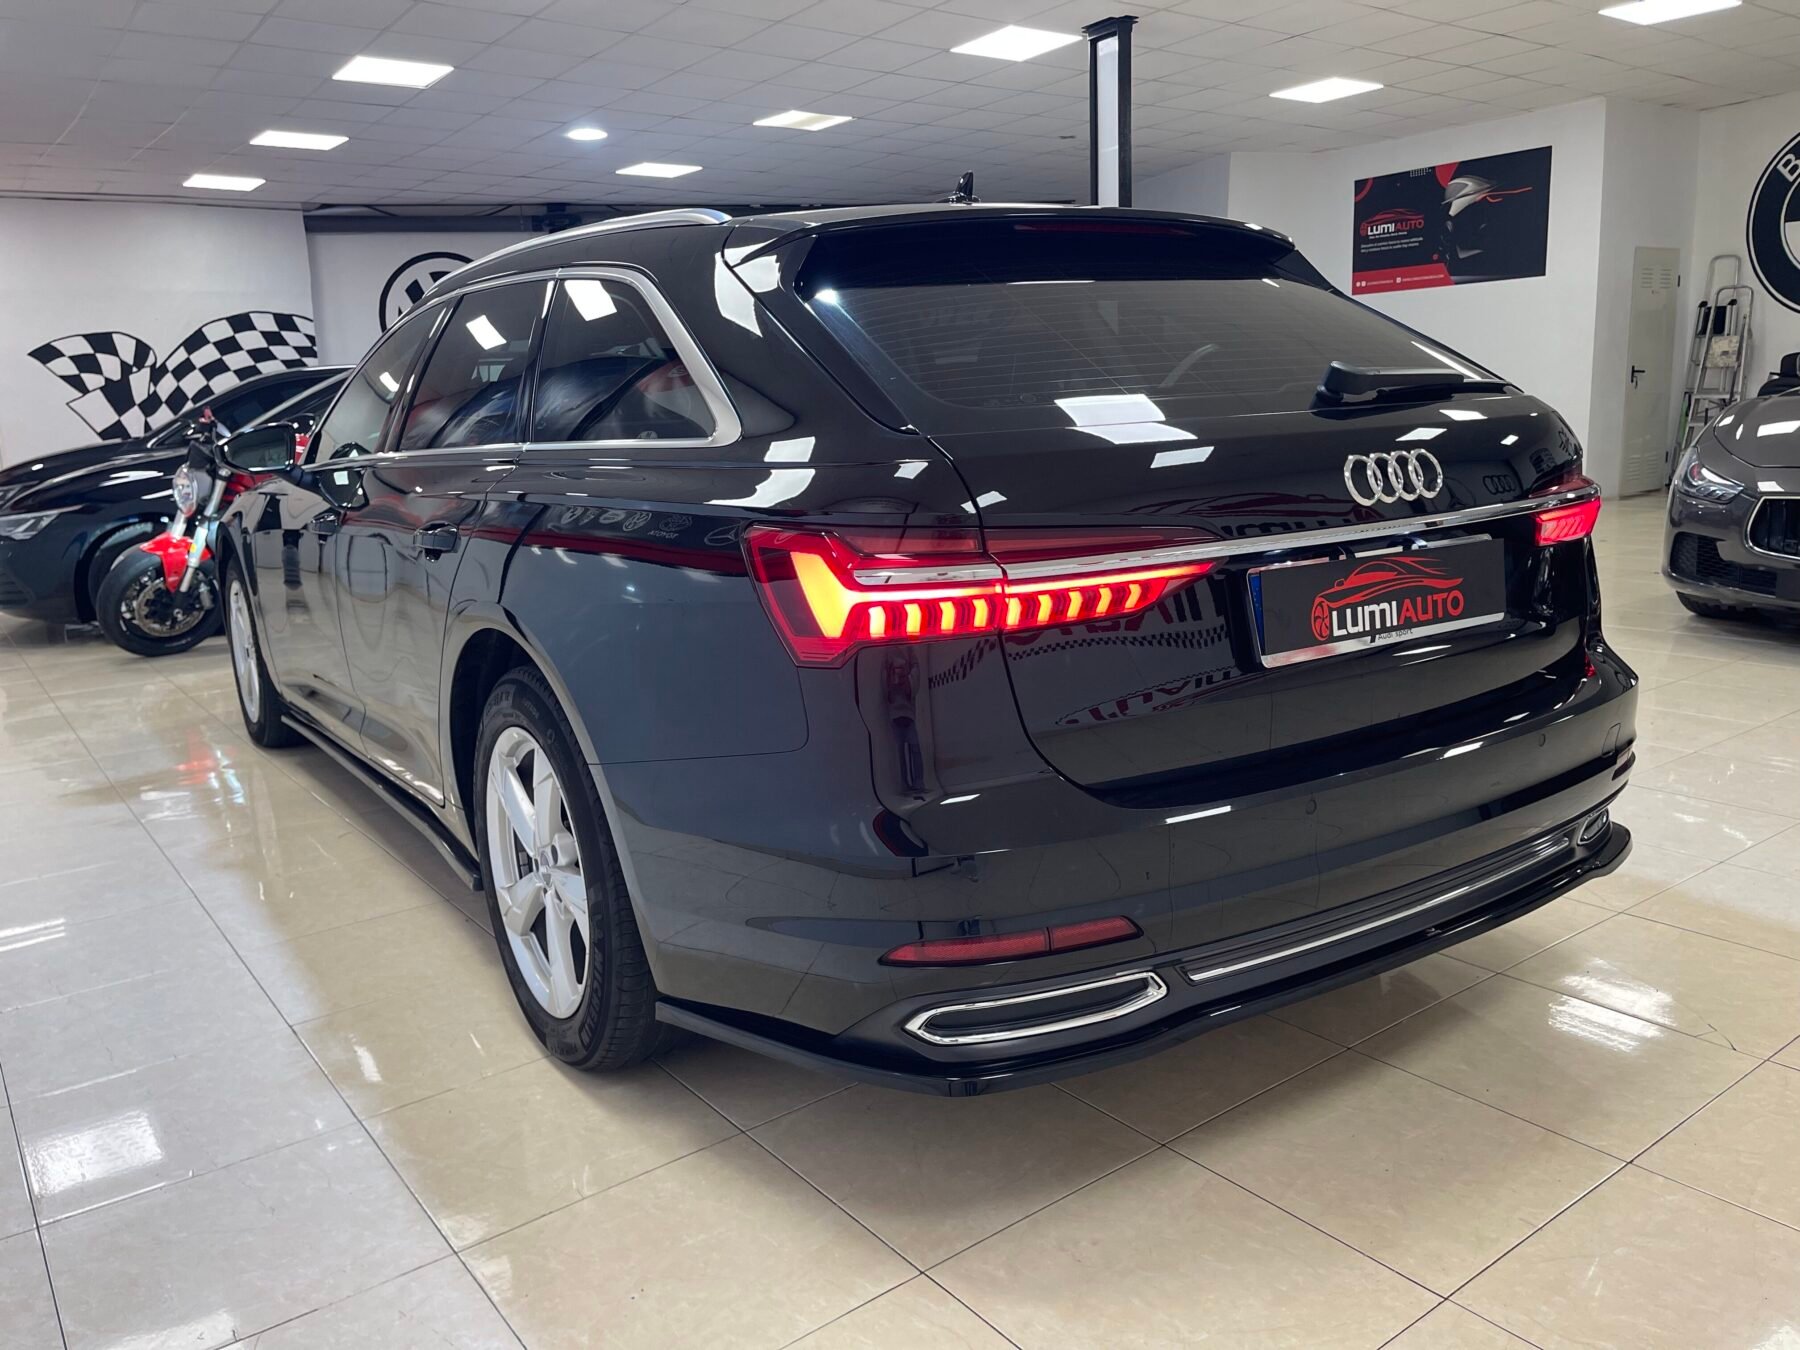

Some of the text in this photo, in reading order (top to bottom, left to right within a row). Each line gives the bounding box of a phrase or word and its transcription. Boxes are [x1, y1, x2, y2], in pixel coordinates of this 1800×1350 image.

[1367, 218, 1424, 236] LUMIAUTO
[1332, 589, 1464, 637] LUMIAUTO
[580, 946, 603, 1048] MICHELIN
